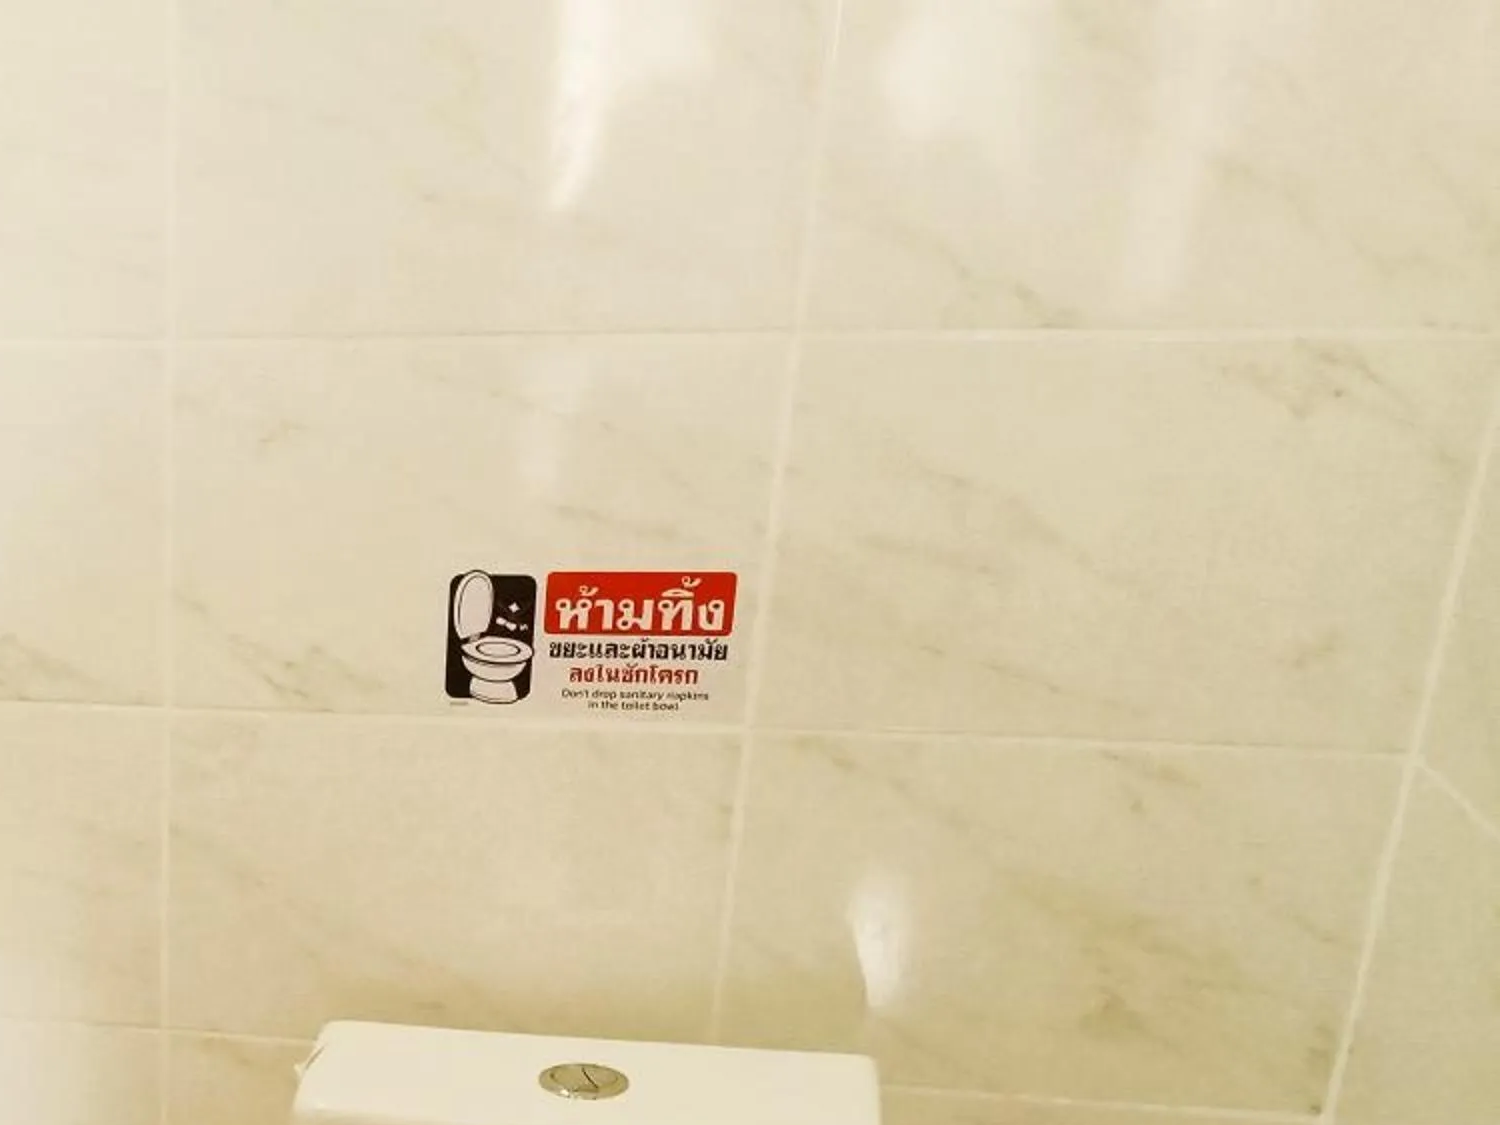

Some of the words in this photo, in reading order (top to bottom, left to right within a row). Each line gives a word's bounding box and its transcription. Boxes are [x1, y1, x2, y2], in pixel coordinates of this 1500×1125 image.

[555, 575, 726, 631] ห้ามทิ้ง
[549, 638, 729, 661] ขยะและผ้าอนามัย
[569, 663, 699, 685] ลงในชักโครก
[588, 701, 599, 709] in
[601, 701, 618, 710] the
[621, 701, 650, 711] toilet
[652, 701, 679, 711] bowl
[592, 689, 617, 701] drop
[619, 689, 664, 702] sanitary
[666, 690, 709, 702] napkins
